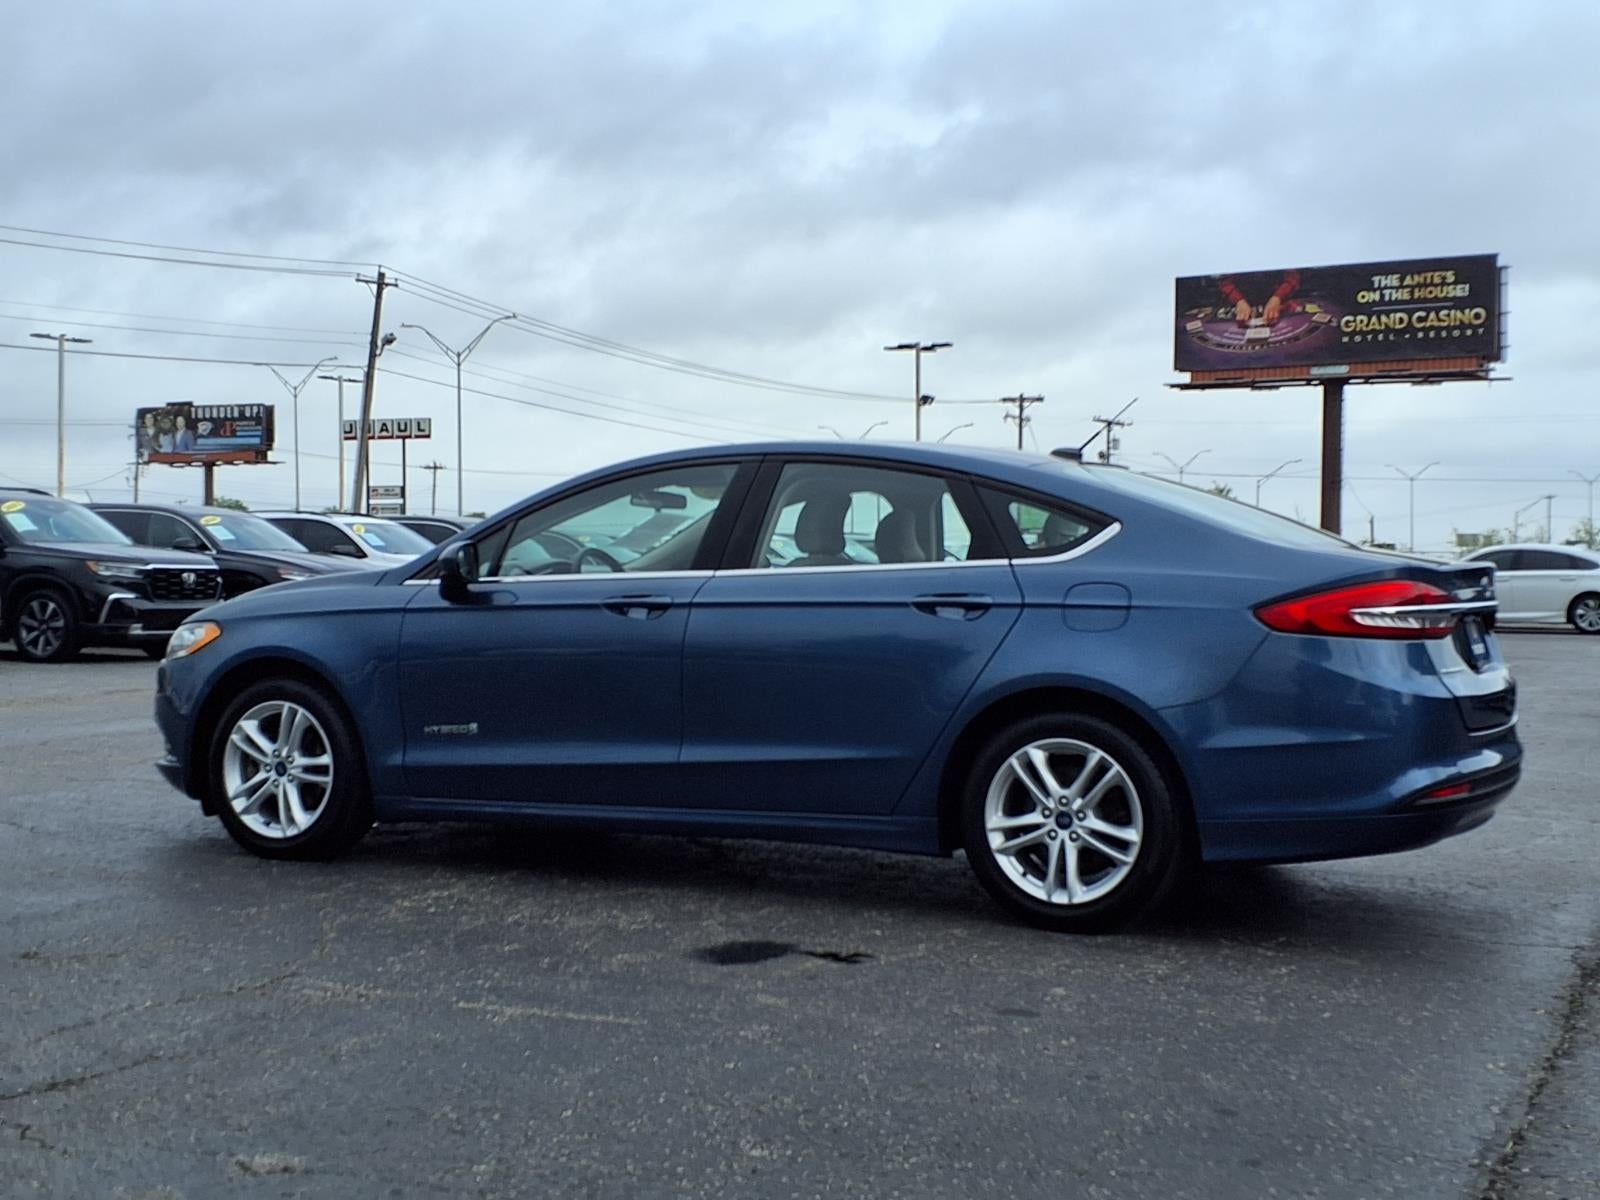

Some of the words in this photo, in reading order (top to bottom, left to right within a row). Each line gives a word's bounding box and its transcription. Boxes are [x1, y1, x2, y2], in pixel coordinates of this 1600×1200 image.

[1371, 274, 1400, 288] THE
[1403, 270, 1456, 286] ANTE'S
[1356, 290, 1380, 303] ON
[1382, 288, 1411, 301] THE
[1414, 284, 1470, 299] HOUSE!
[1340, 312, 1409, 332] GRAND
[1411, 307, 1487, 328] CASINO
[1341, 333, 1395, 343] HOTEL
